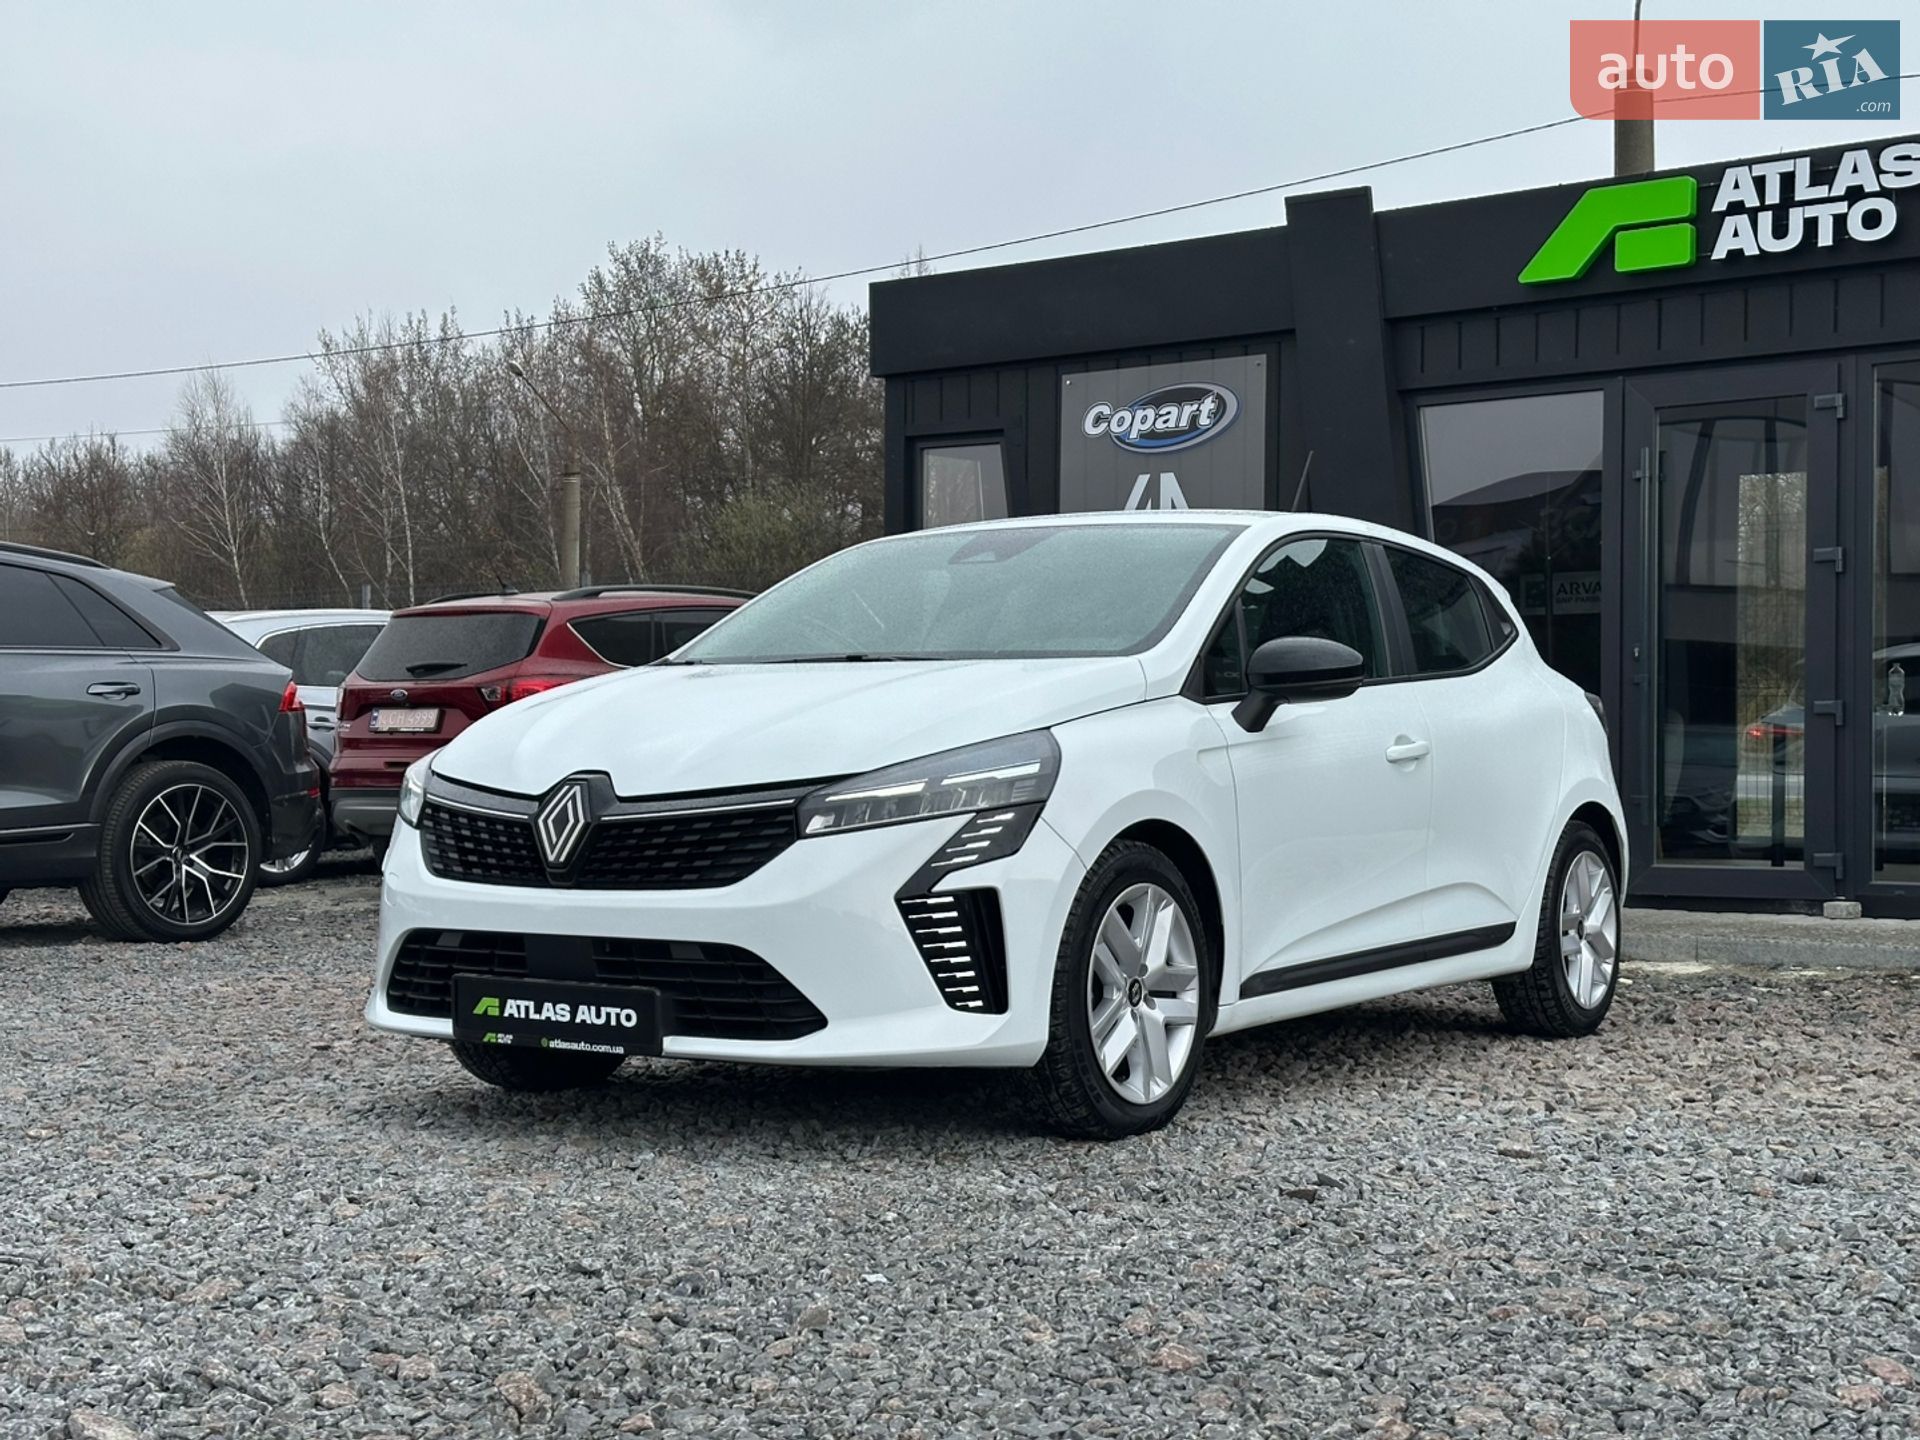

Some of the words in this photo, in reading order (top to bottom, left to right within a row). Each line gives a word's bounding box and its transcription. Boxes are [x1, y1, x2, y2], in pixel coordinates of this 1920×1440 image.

[1711, 143, 1920, 212] ATLAS
[1711, 197, 1898, 260] AUTO
[1083, 391, 1218, 439] Copart
[503, 999, 571, 1023] ATLAS
[575, 1005, 638, 1028] AUTO
[549, 1038, 624, 1054] atlasauto.com.ua
